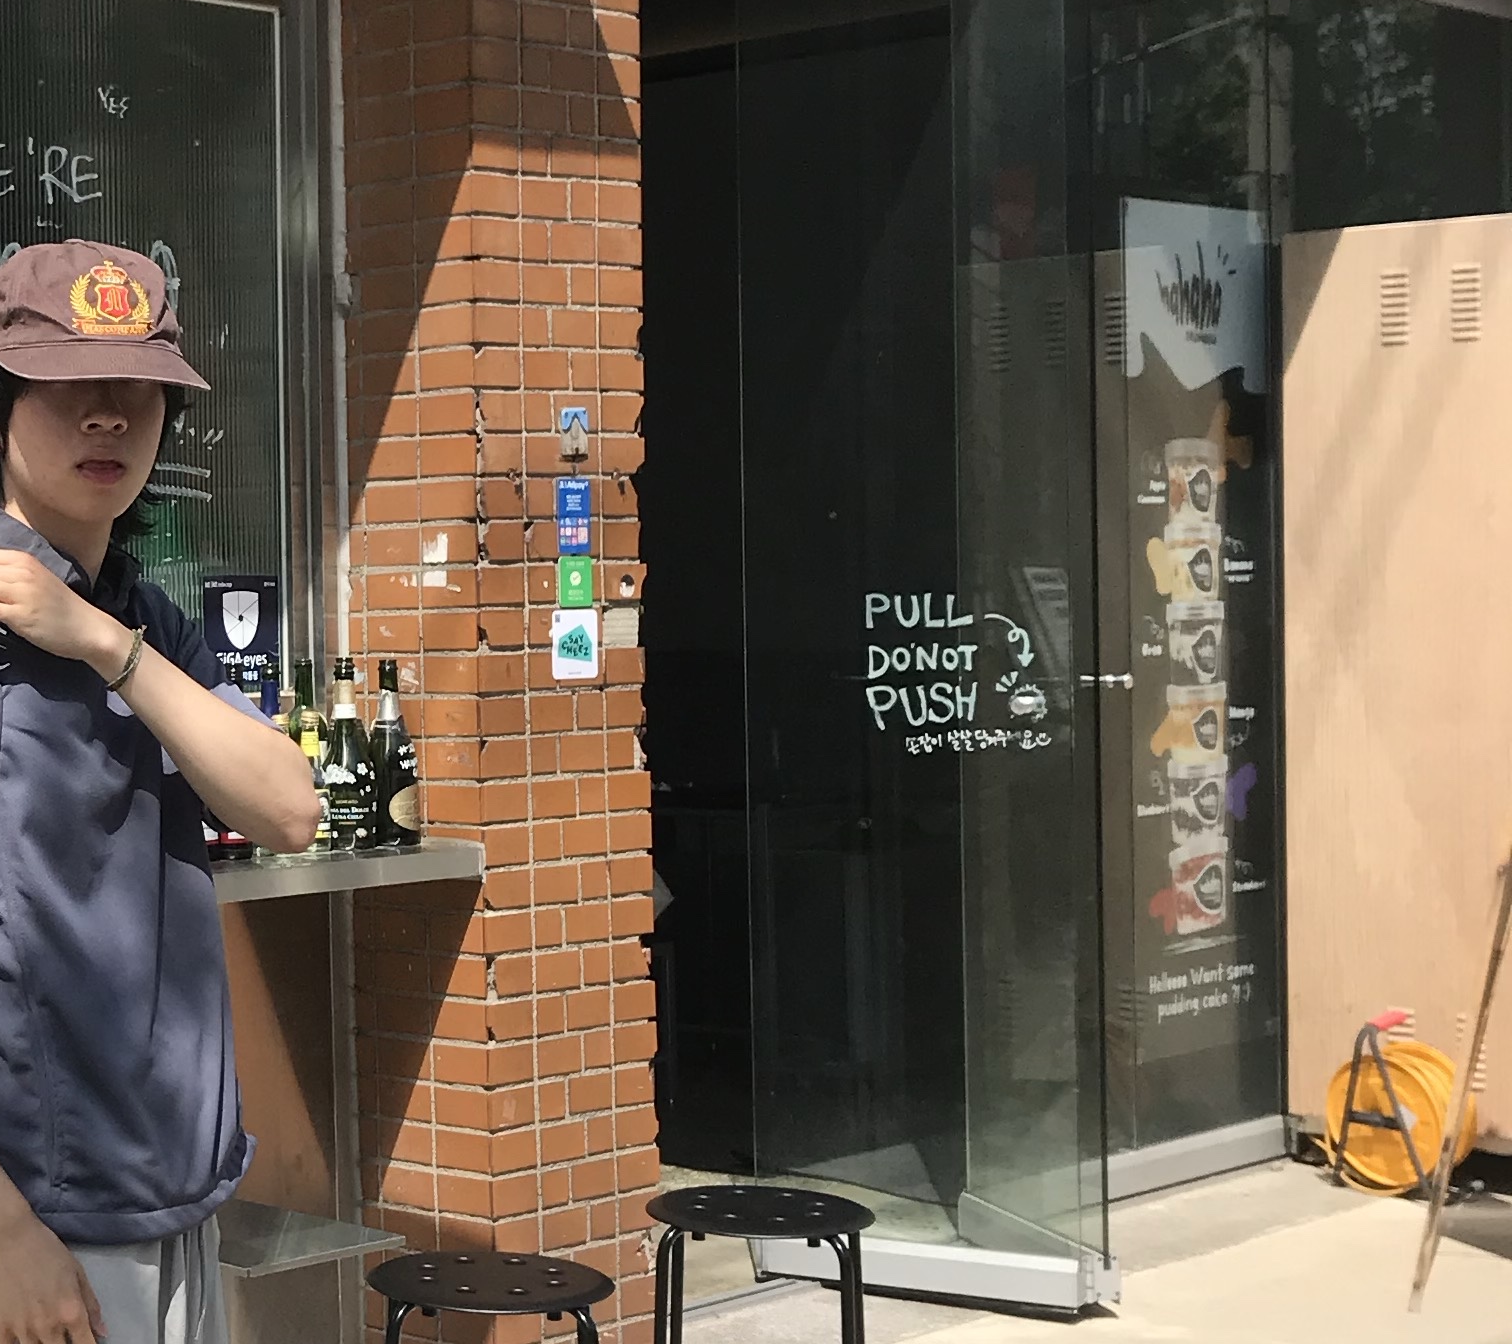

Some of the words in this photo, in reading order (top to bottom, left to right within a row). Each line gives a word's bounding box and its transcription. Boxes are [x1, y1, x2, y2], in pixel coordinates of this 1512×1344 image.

[97, 86, 130, 118] YES
[865, 593, 974, 629] PULL
[865, 681, 978, 731] PUSH
[1190, 962, 1224, 985] Want
